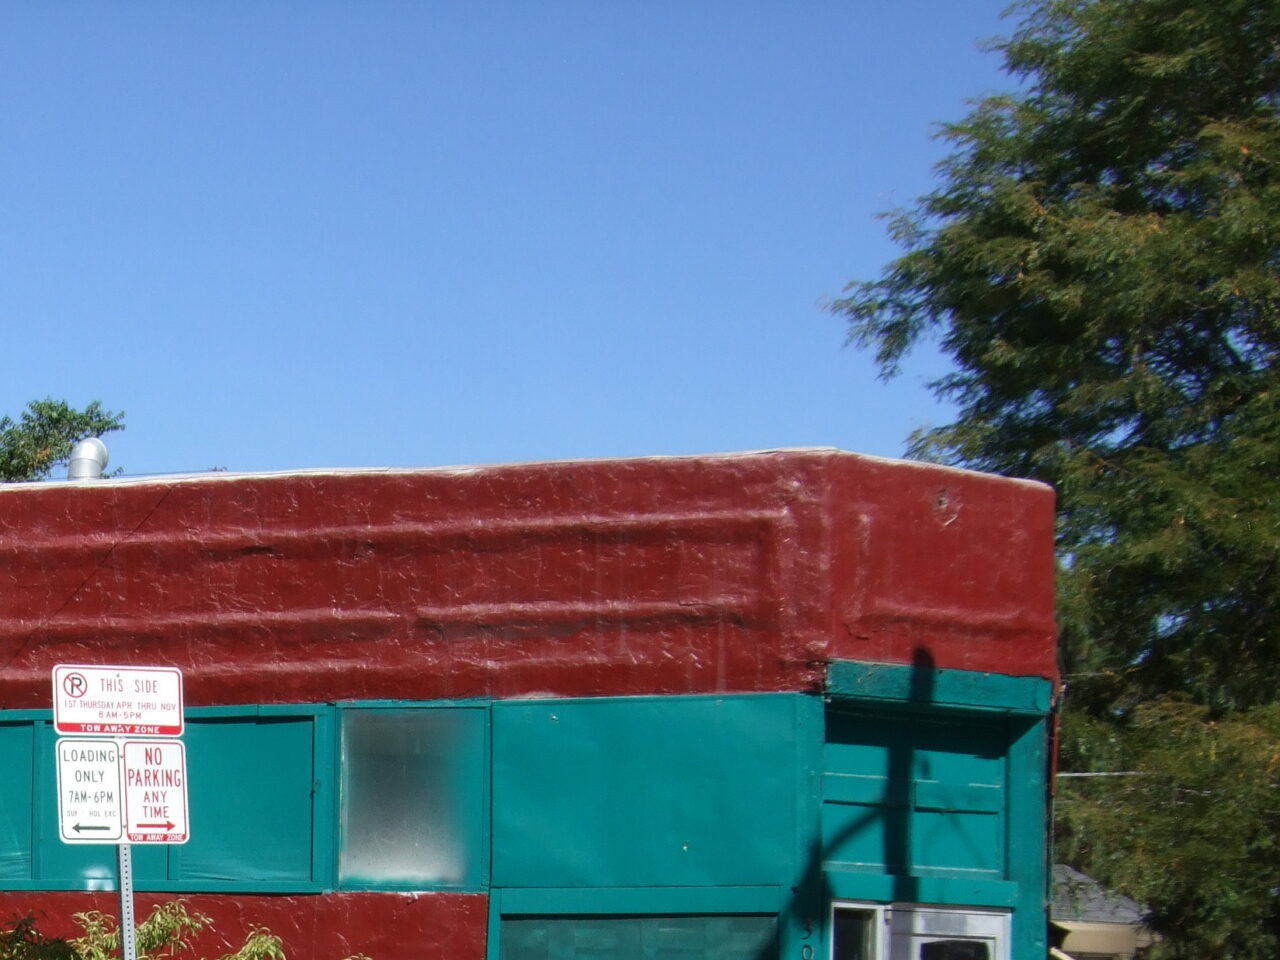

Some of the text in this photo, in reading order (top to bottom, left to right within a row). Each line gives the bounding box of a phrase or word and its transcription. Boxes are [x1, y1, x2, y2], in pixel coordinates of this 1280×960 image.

[100, 678, 124, 692] THIS
[135, 679, 158, 693] SIDE
[80, 700, 114, 709] THURSDAY
[137, 702, 157, 710] THRU
[81, 724, 160, 734] TOW AWAY ZONE
[63, 749, 115, 762] LOADING
[145, 747, 162, 766] NO
[75, 770, 105, 783] ONLY
[128, 769, 181, 787] PARKING
[143, 791, 167, 803] ANY
[142, 806, 170, 818] TIME
[167, 833, 183, 841] ZONE
